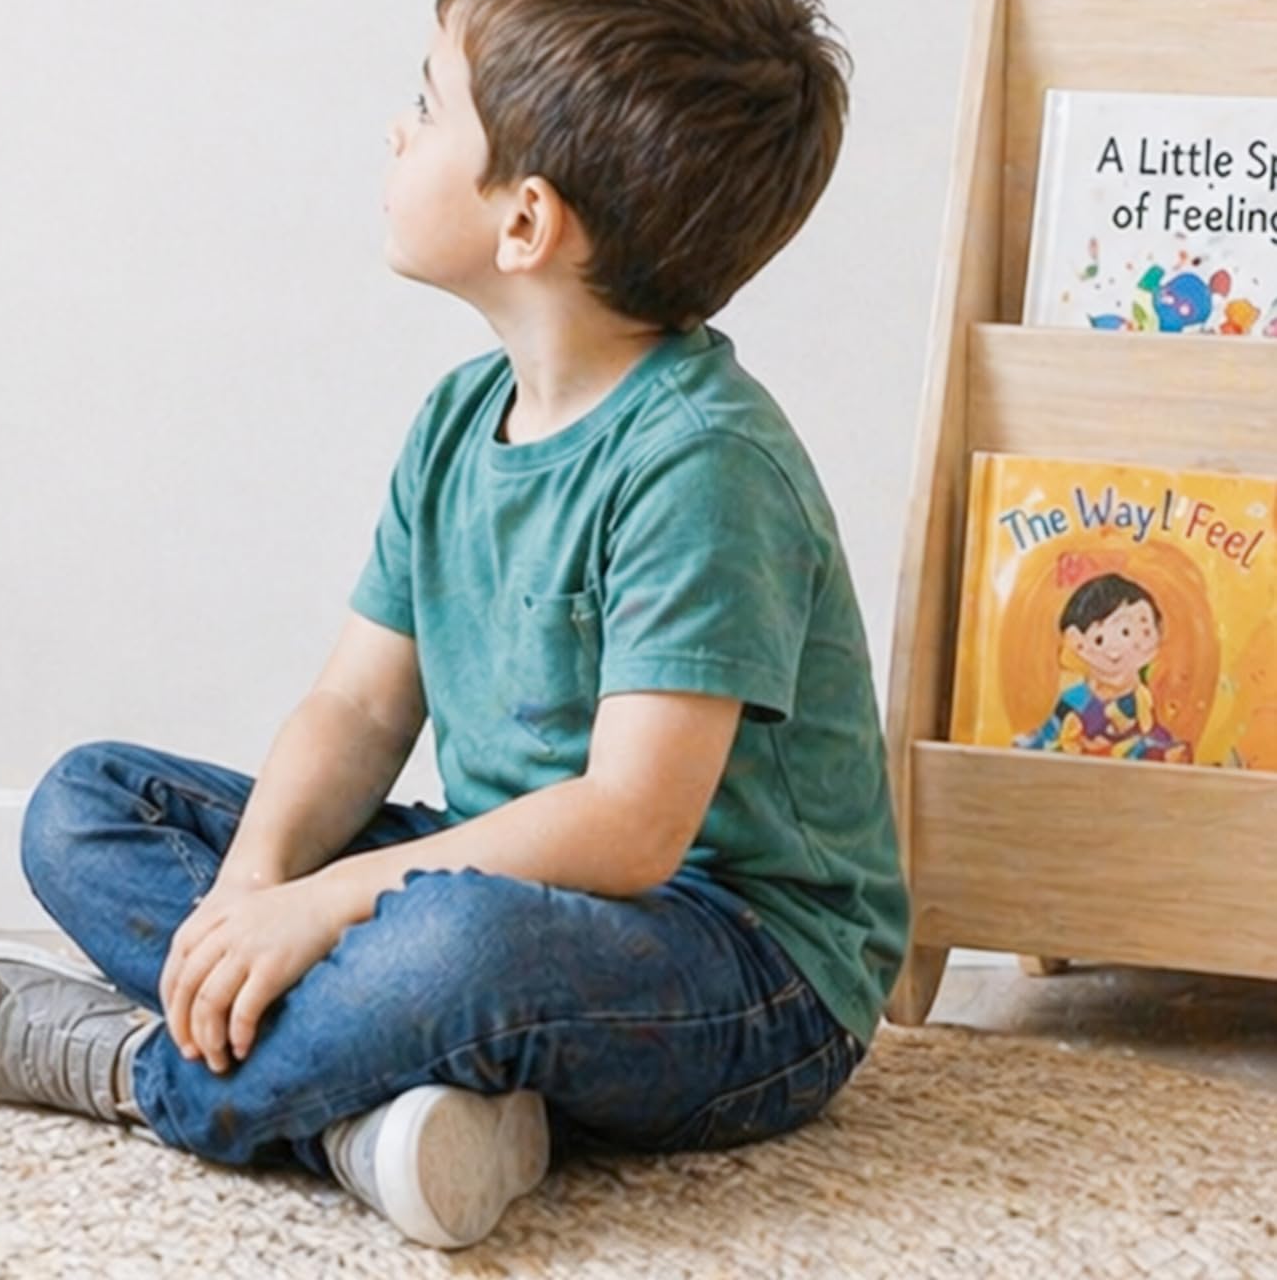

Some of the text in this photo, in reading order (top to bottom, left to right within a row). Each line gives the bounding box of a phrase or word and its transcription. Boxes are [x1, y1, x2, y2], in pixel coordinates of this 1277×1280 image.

[1097, 137, 1123, 172] A
[1140, 138, 1233, 177] Little
[1113, 191, 1150, 229] of
[1076, 488, 1154, 542] Way
[1185, 502, 1263, 568] Feel
